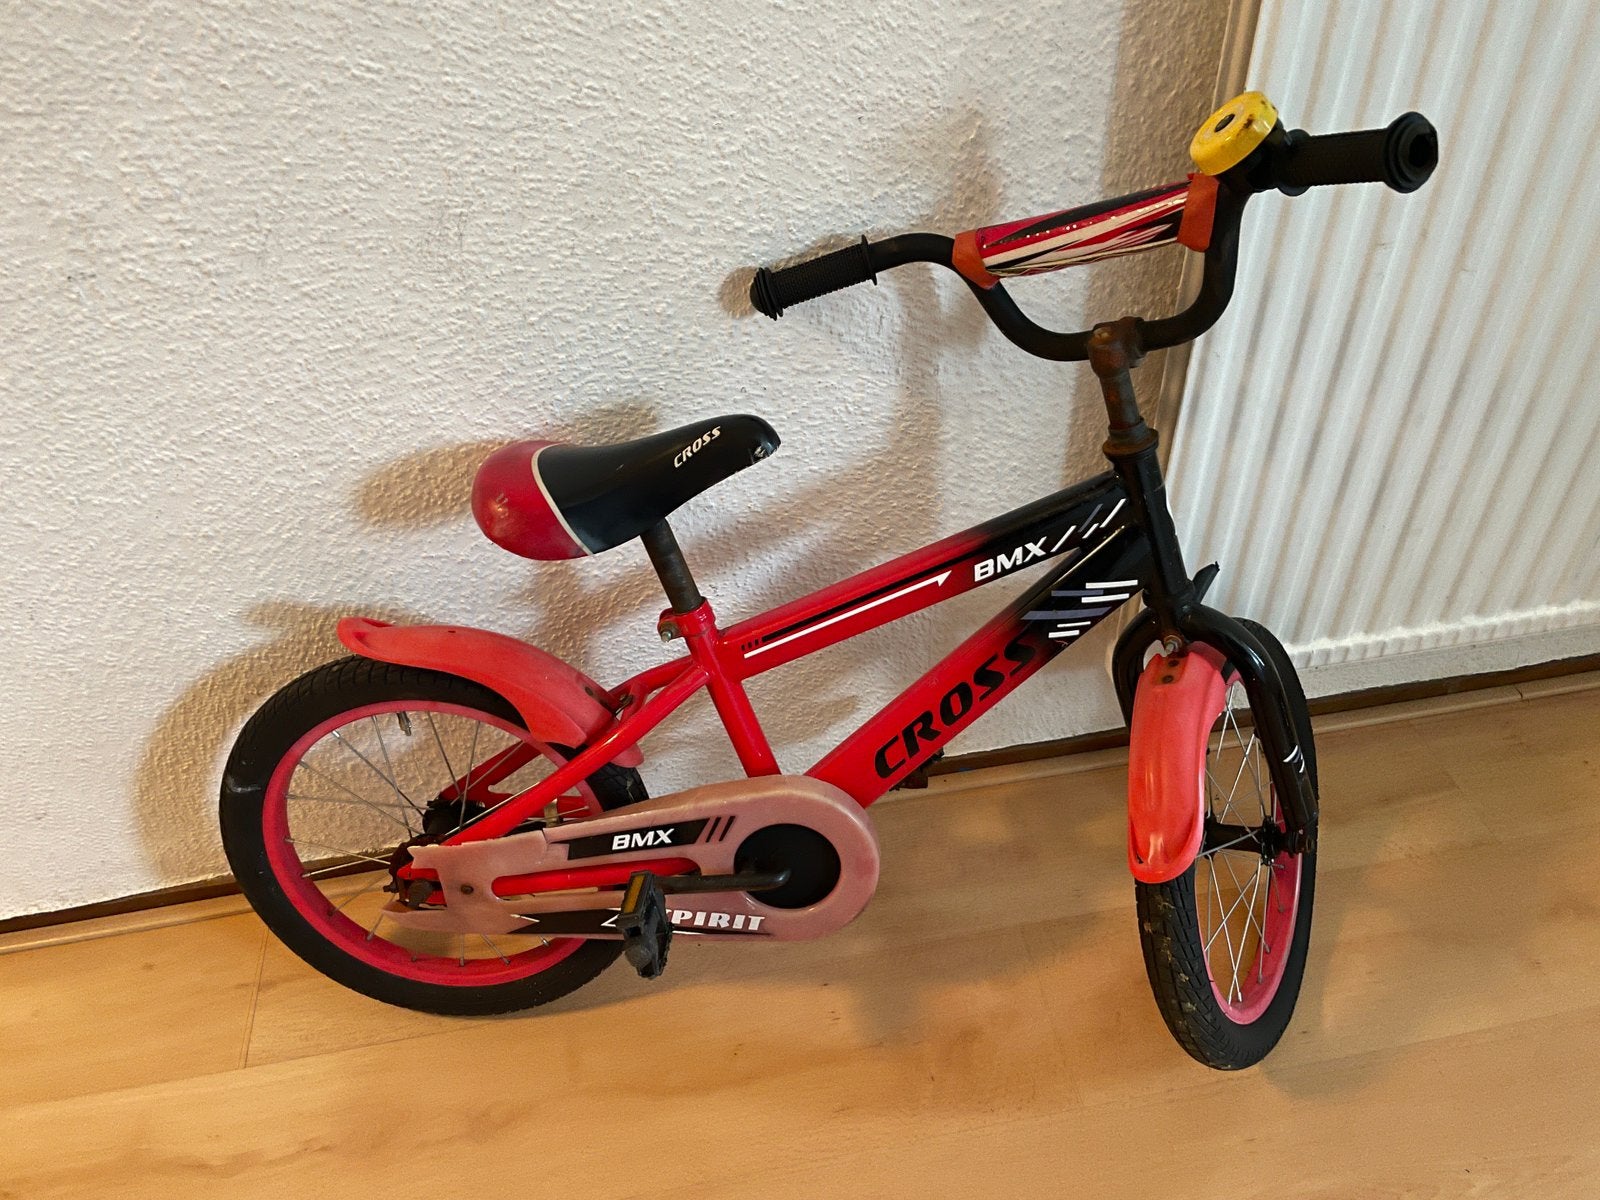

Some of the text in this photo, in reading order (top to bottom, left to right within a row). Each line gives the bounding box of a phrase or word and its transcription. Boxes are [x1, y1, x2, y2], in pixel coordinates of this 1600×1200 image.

[673, 425, 721, 468] CROSS
[974, 536, 1048, 582] BMX
[874, 636, 1036, 779] CROSS
[612, 828, 675, 850] BMX
[665, 909, 765, 931] PIRIT
